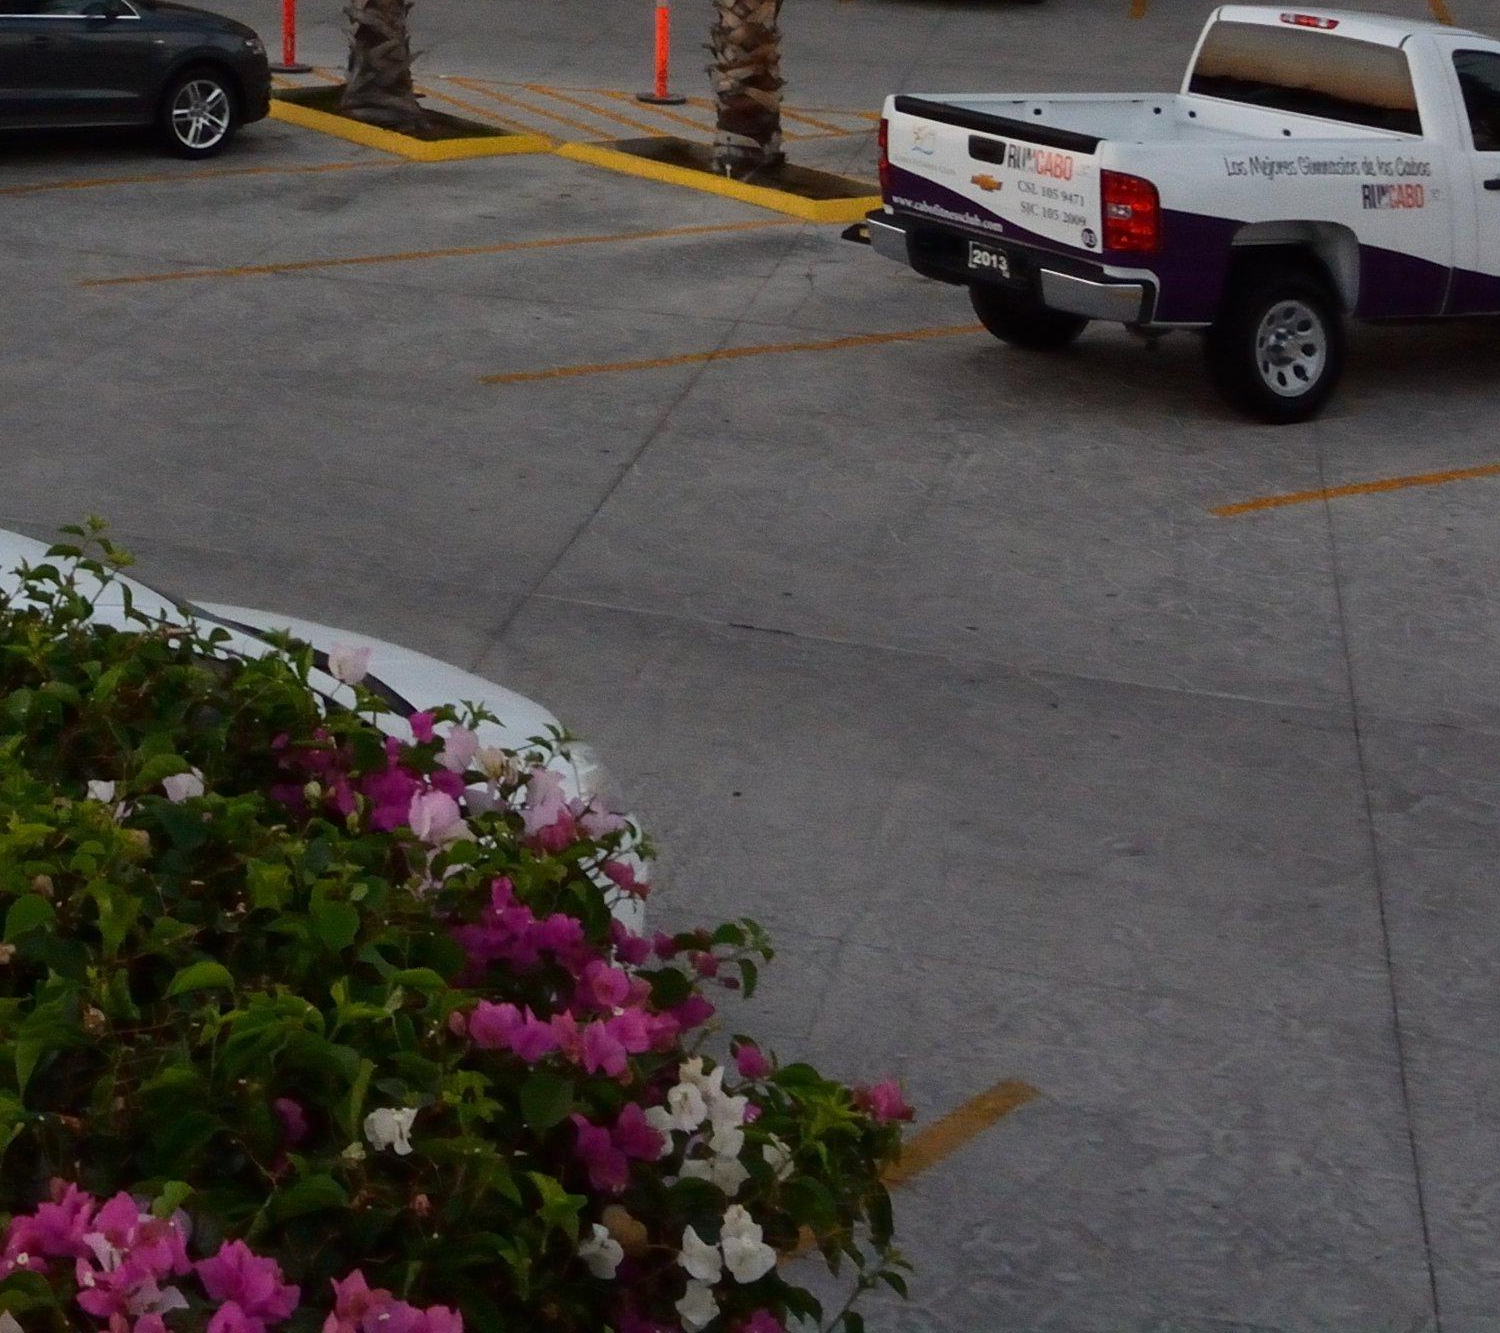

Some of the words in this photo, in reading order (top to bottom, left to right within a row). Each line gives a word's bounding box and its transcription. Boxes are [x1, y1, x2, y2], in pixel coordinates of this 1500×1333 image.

[1224, 157, 1248, 177] Los
[1250, 155, 1297, 181] Mejores
[1362, 157, 1376, 177] de
[1017, 180, 1038, 196] CSL
[1060, 190, 1085, 207] 9471
[1060, 210, 1087, 227] 2009
[972, 249, 1008, 271] 2013
